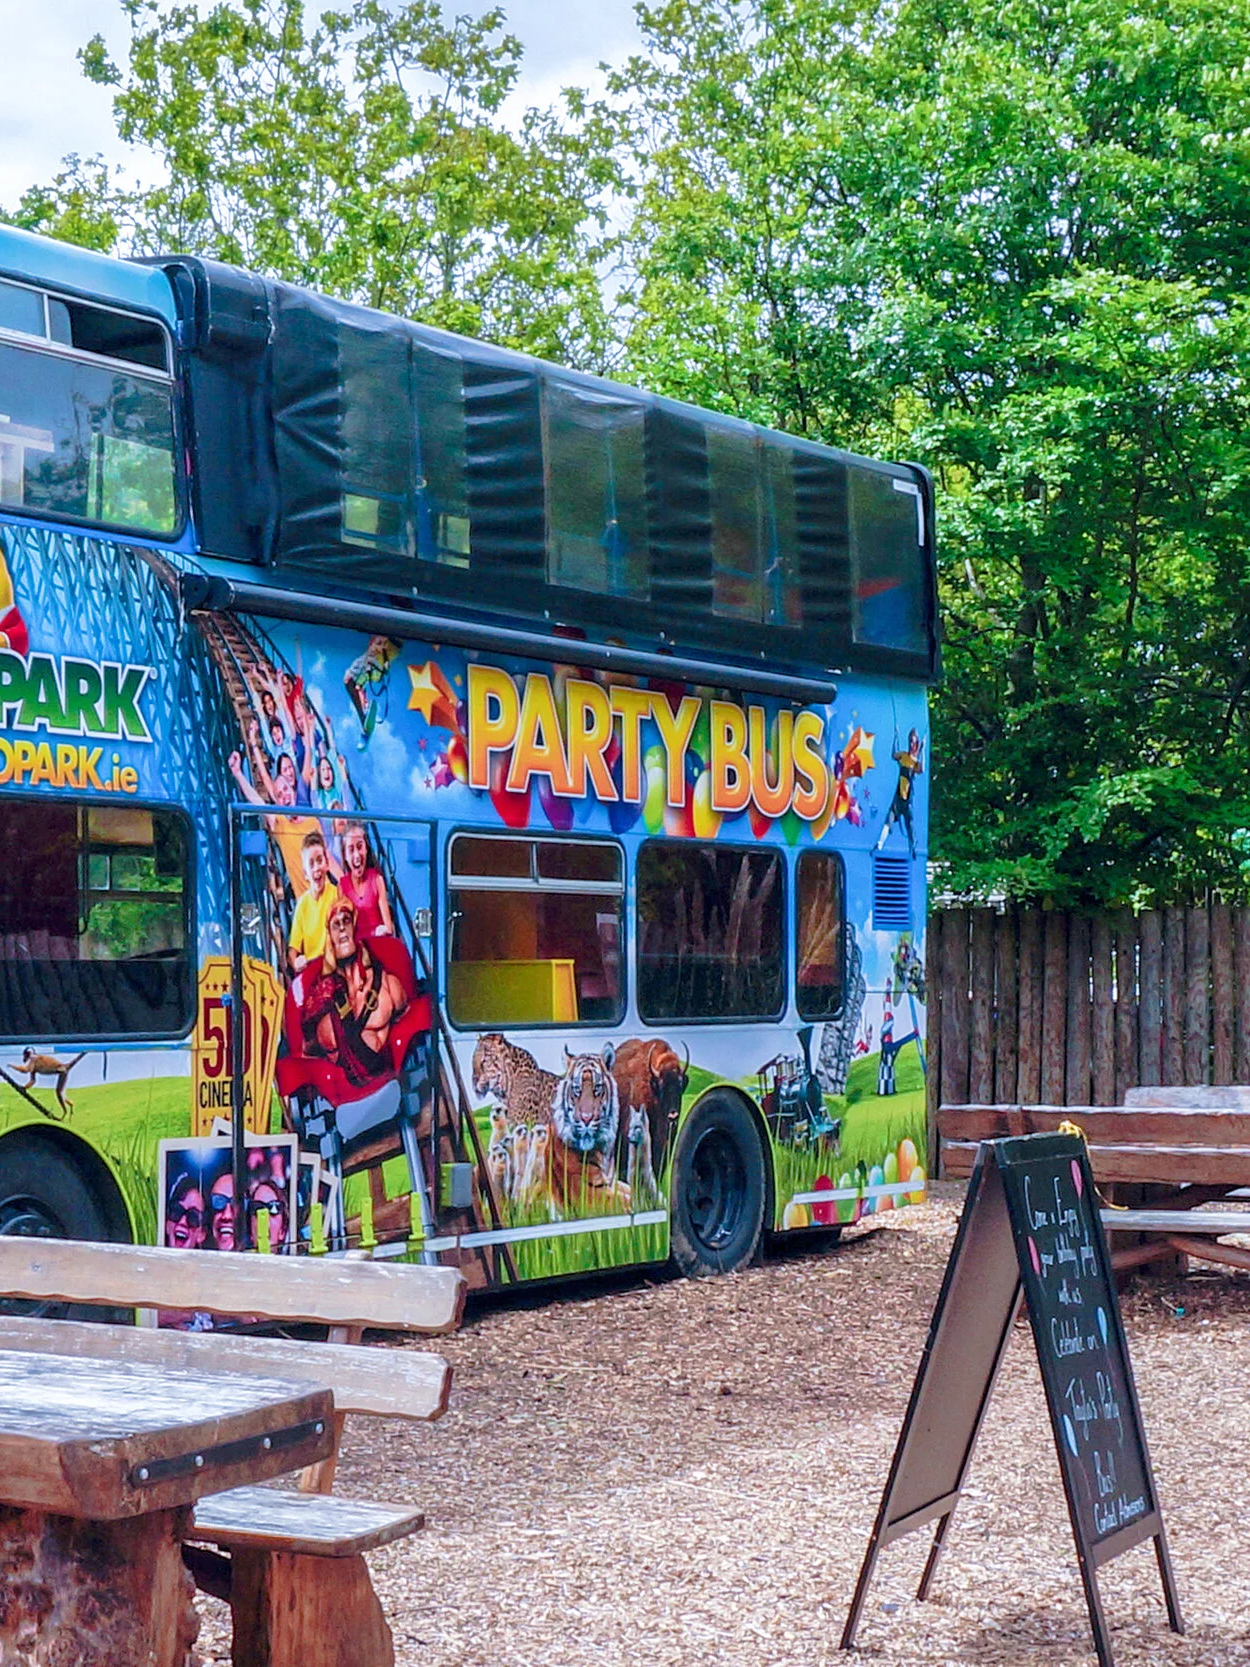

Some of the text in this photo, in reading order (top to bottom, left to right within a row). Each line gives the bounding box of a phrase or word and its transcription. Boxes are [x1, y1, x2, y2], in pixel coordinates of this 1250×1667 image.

[466, 663, 829, 821] PARTY BUS
[199, 1080, 253, 1109] CINEA
